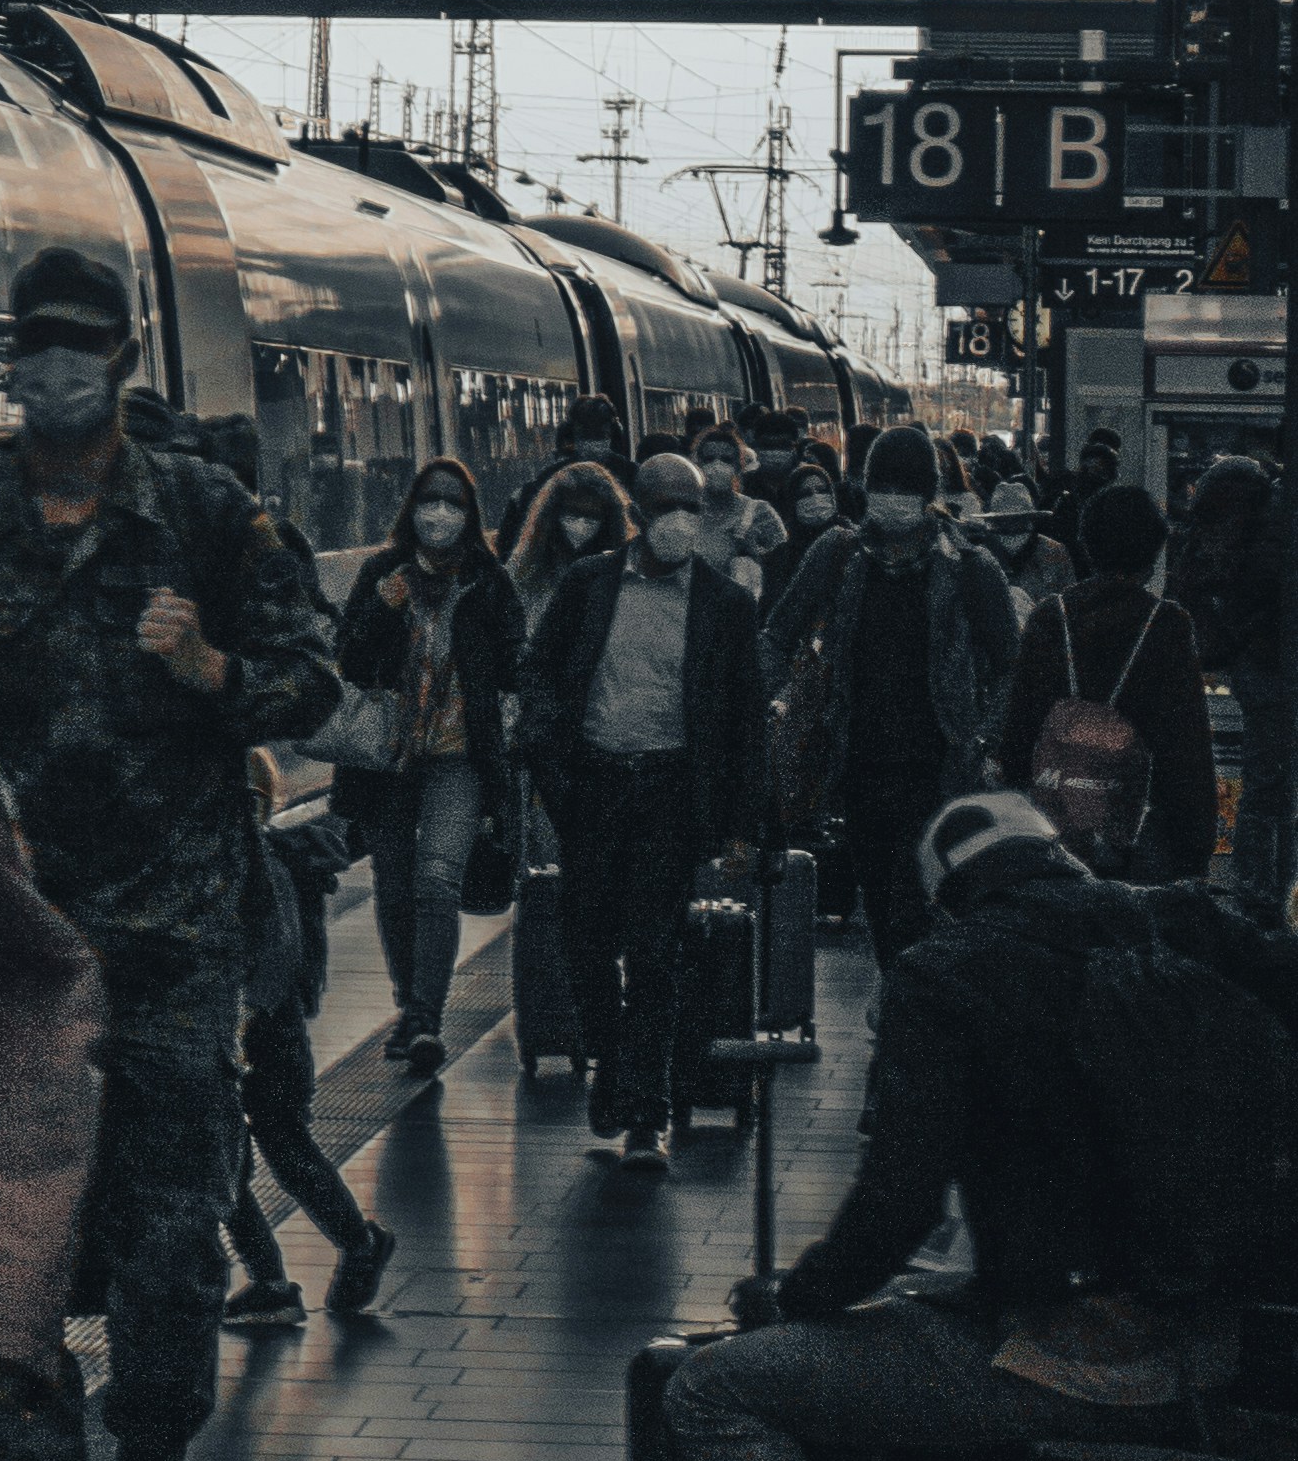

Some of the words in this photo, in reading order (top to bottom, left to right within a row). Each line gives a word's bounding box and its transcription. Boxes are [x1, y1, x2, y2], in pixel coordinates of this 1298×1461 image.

[862, 101, 964, 189] 18
[1048, 106, 1111, 191] B
[1084, 267, 1146, 297] 1-17
[953, 322, 991, 357] 18
